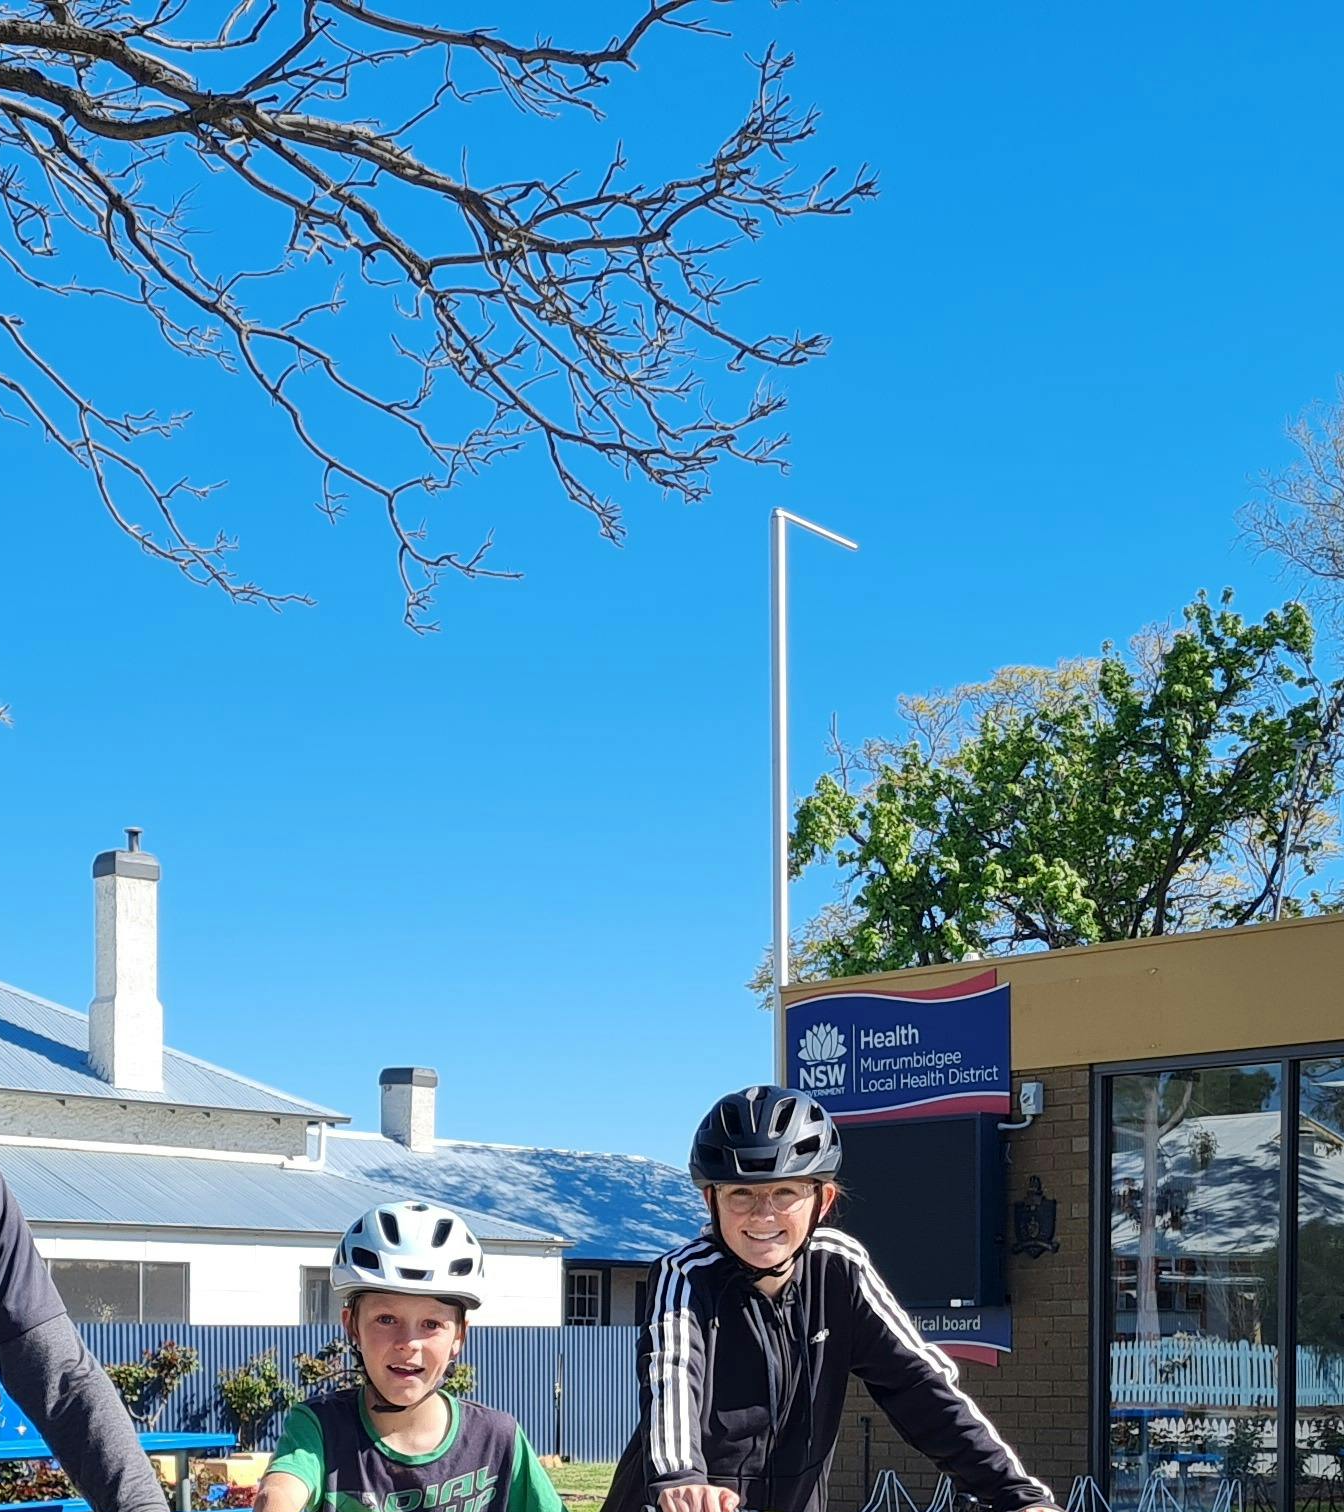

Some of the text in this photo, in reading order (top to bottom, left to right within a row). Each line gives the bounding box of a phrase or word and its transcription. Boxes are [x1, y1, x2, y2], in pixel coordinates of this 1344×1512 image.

[860, 1024, 920, 1050] Health
[859, 1050, 962, 1073] Murrumbidgee
[799, 1063, 846, 1089] NSW
[860, 1065, 999, 1093] Local Health District
[803, 1086, 846, 1098] OVERNMENT
[942, 1314, 981, 1331] board
